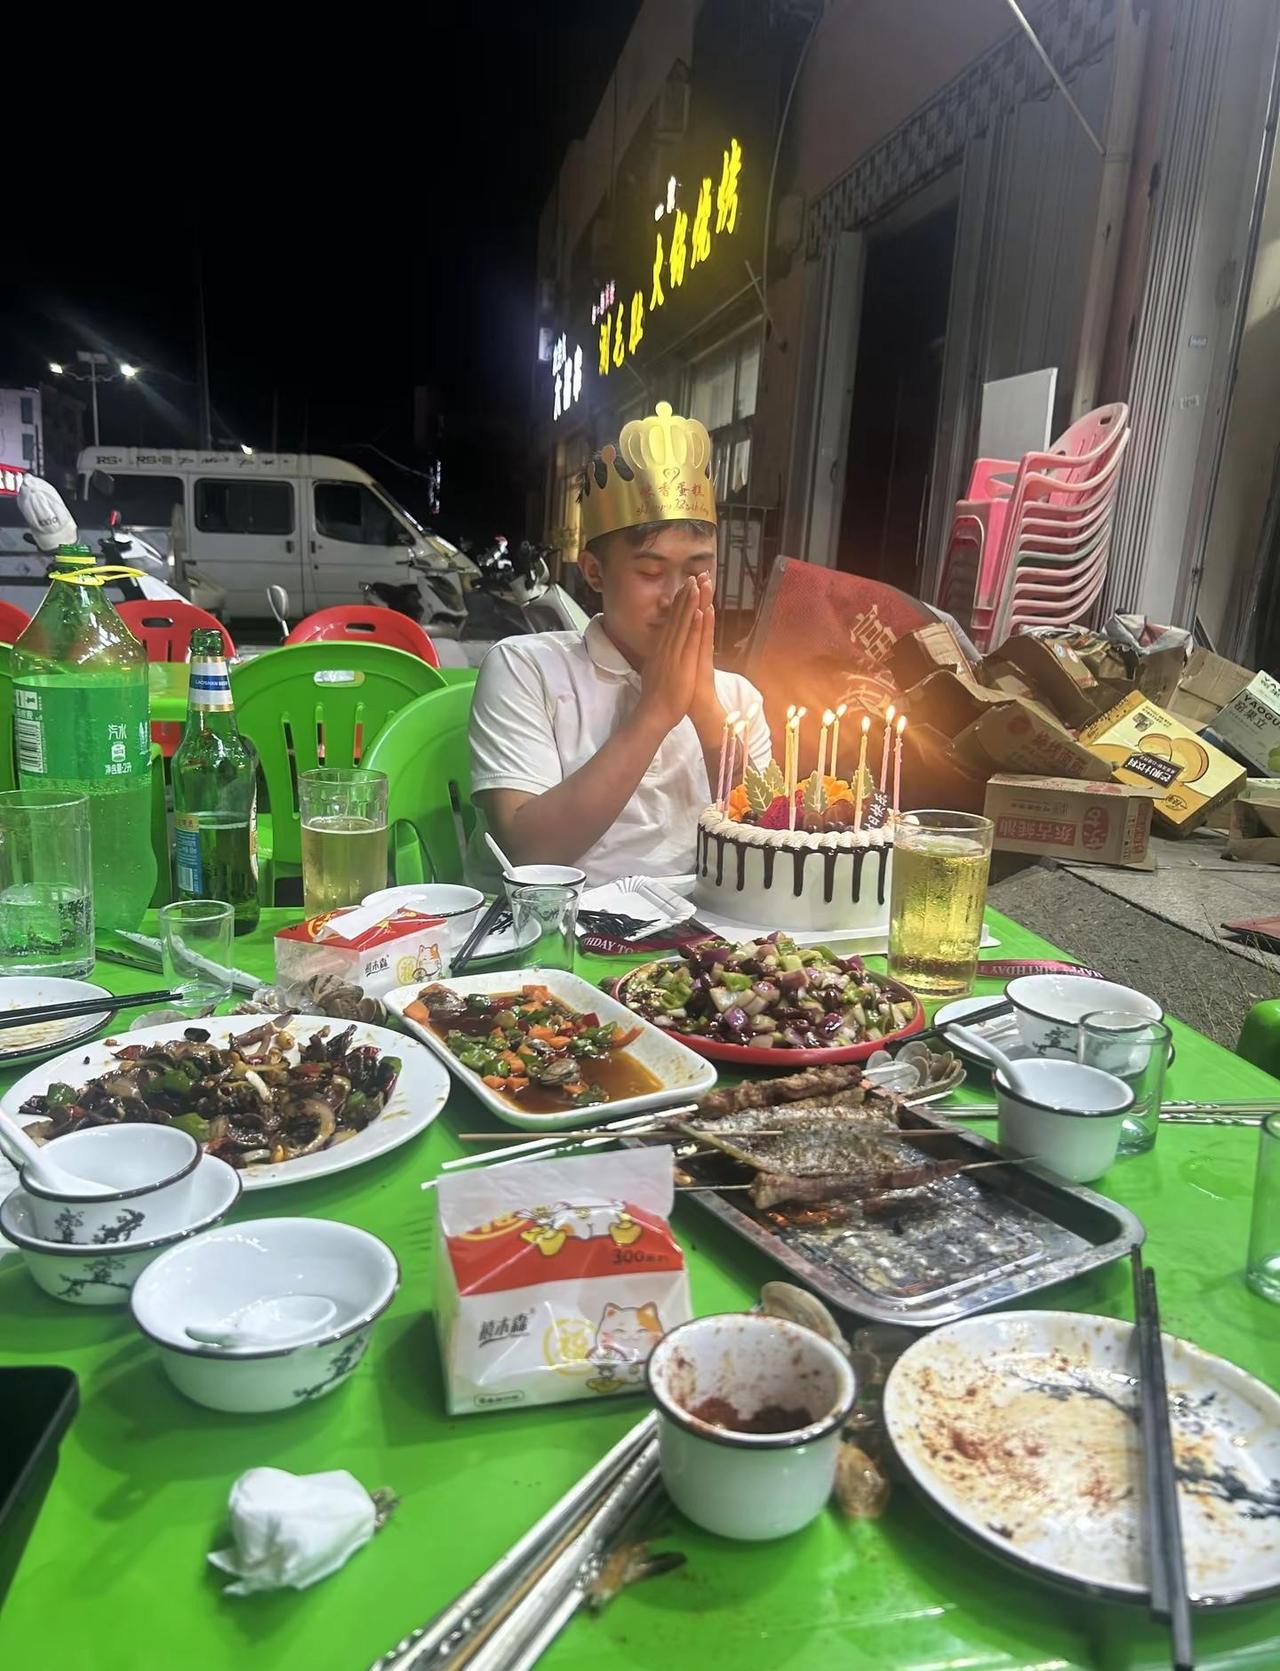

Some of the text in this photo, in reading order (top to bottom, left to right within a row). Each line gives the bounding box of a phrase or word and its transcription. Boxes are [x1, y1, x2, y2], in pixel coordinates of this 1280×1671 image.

[1243, 694, 1280, 728] YAOGU
[108, 722, 127, 741] 汽水
[1127, 757, 1173, 787] 芒果汁饮料
